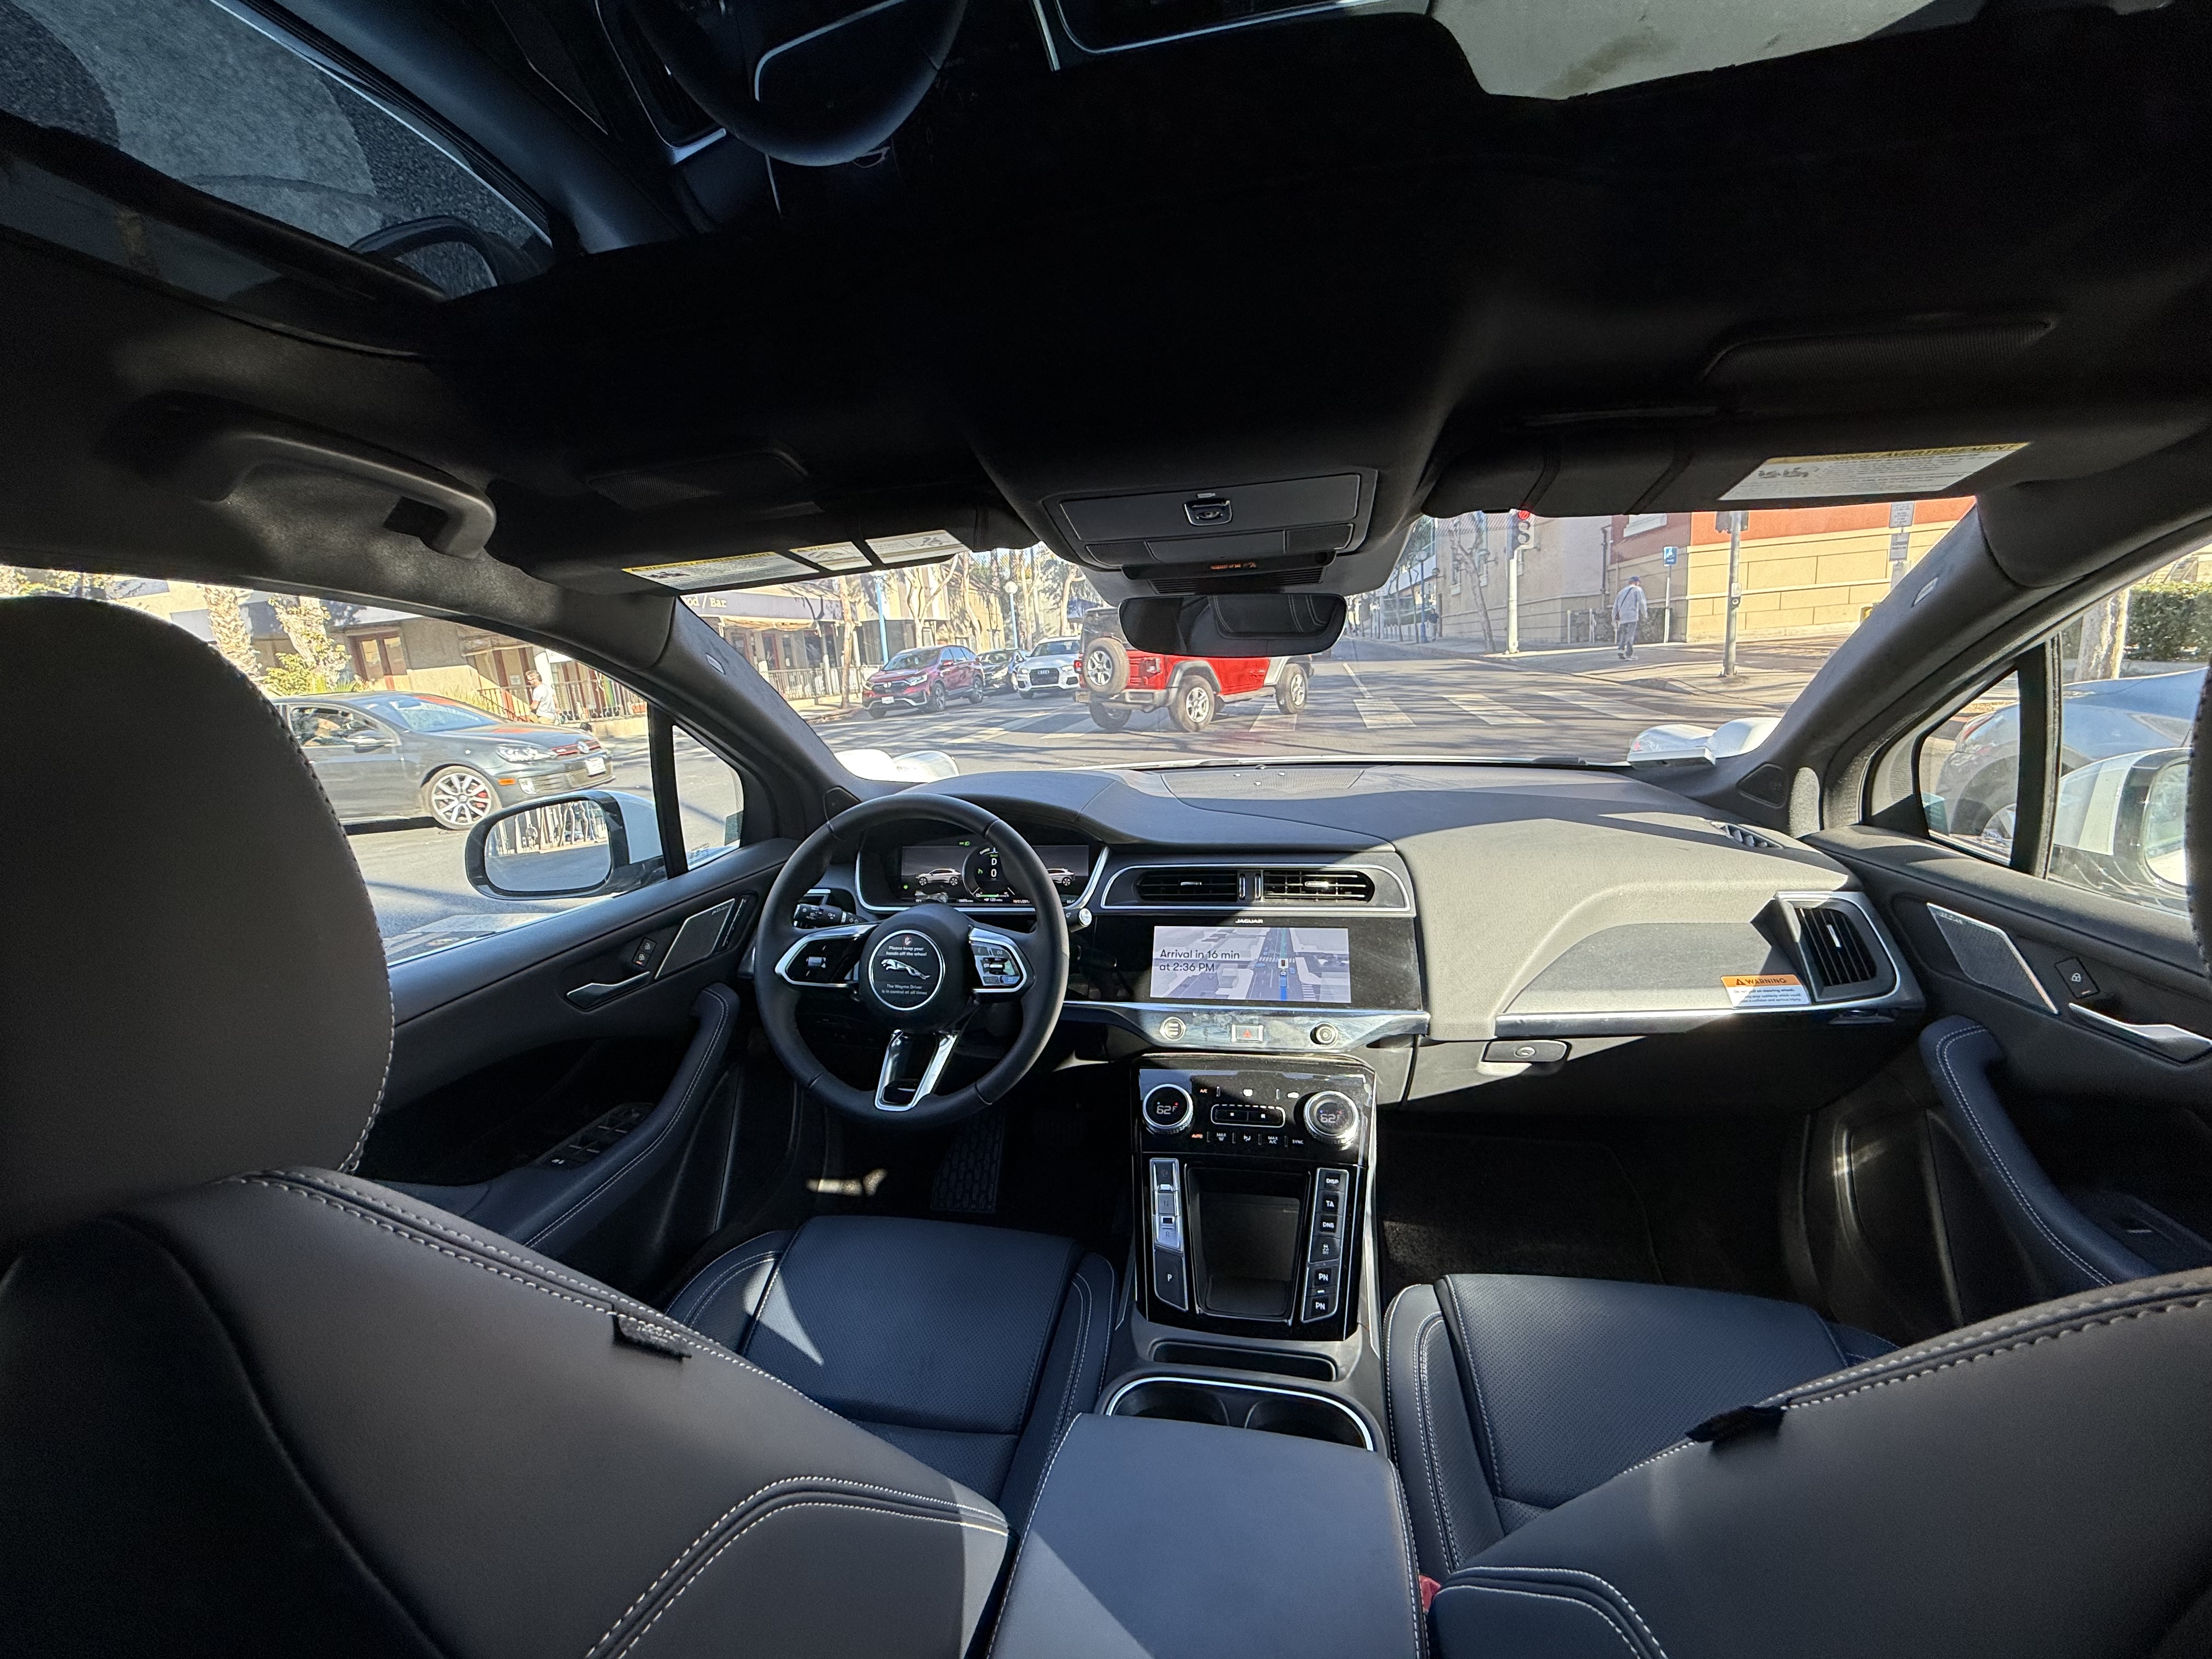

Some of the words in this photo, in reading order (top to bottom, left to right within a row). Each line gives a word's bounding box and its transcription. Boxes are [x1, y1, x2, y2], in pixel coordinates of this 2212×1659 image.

[709, 597, 727, 608] Bar
[991, 857, 997, 866] D
[1160, 949, 1192, 958] Arrival
[1195, 950, 1204, 958] in
[1207, 950, 1218, 958] 16
[1221, 950, 1240, 959] min
[1159, 963, 1170, 971] at
[1173, 963, 1195, 971] 2:36
[1199, 963, 1215, 972] PM
[1167, 1274, 1172, 1282] P
[1318, 1273, 1329, 1282] PN
[1315, 1302, 1325, 1311] PN
